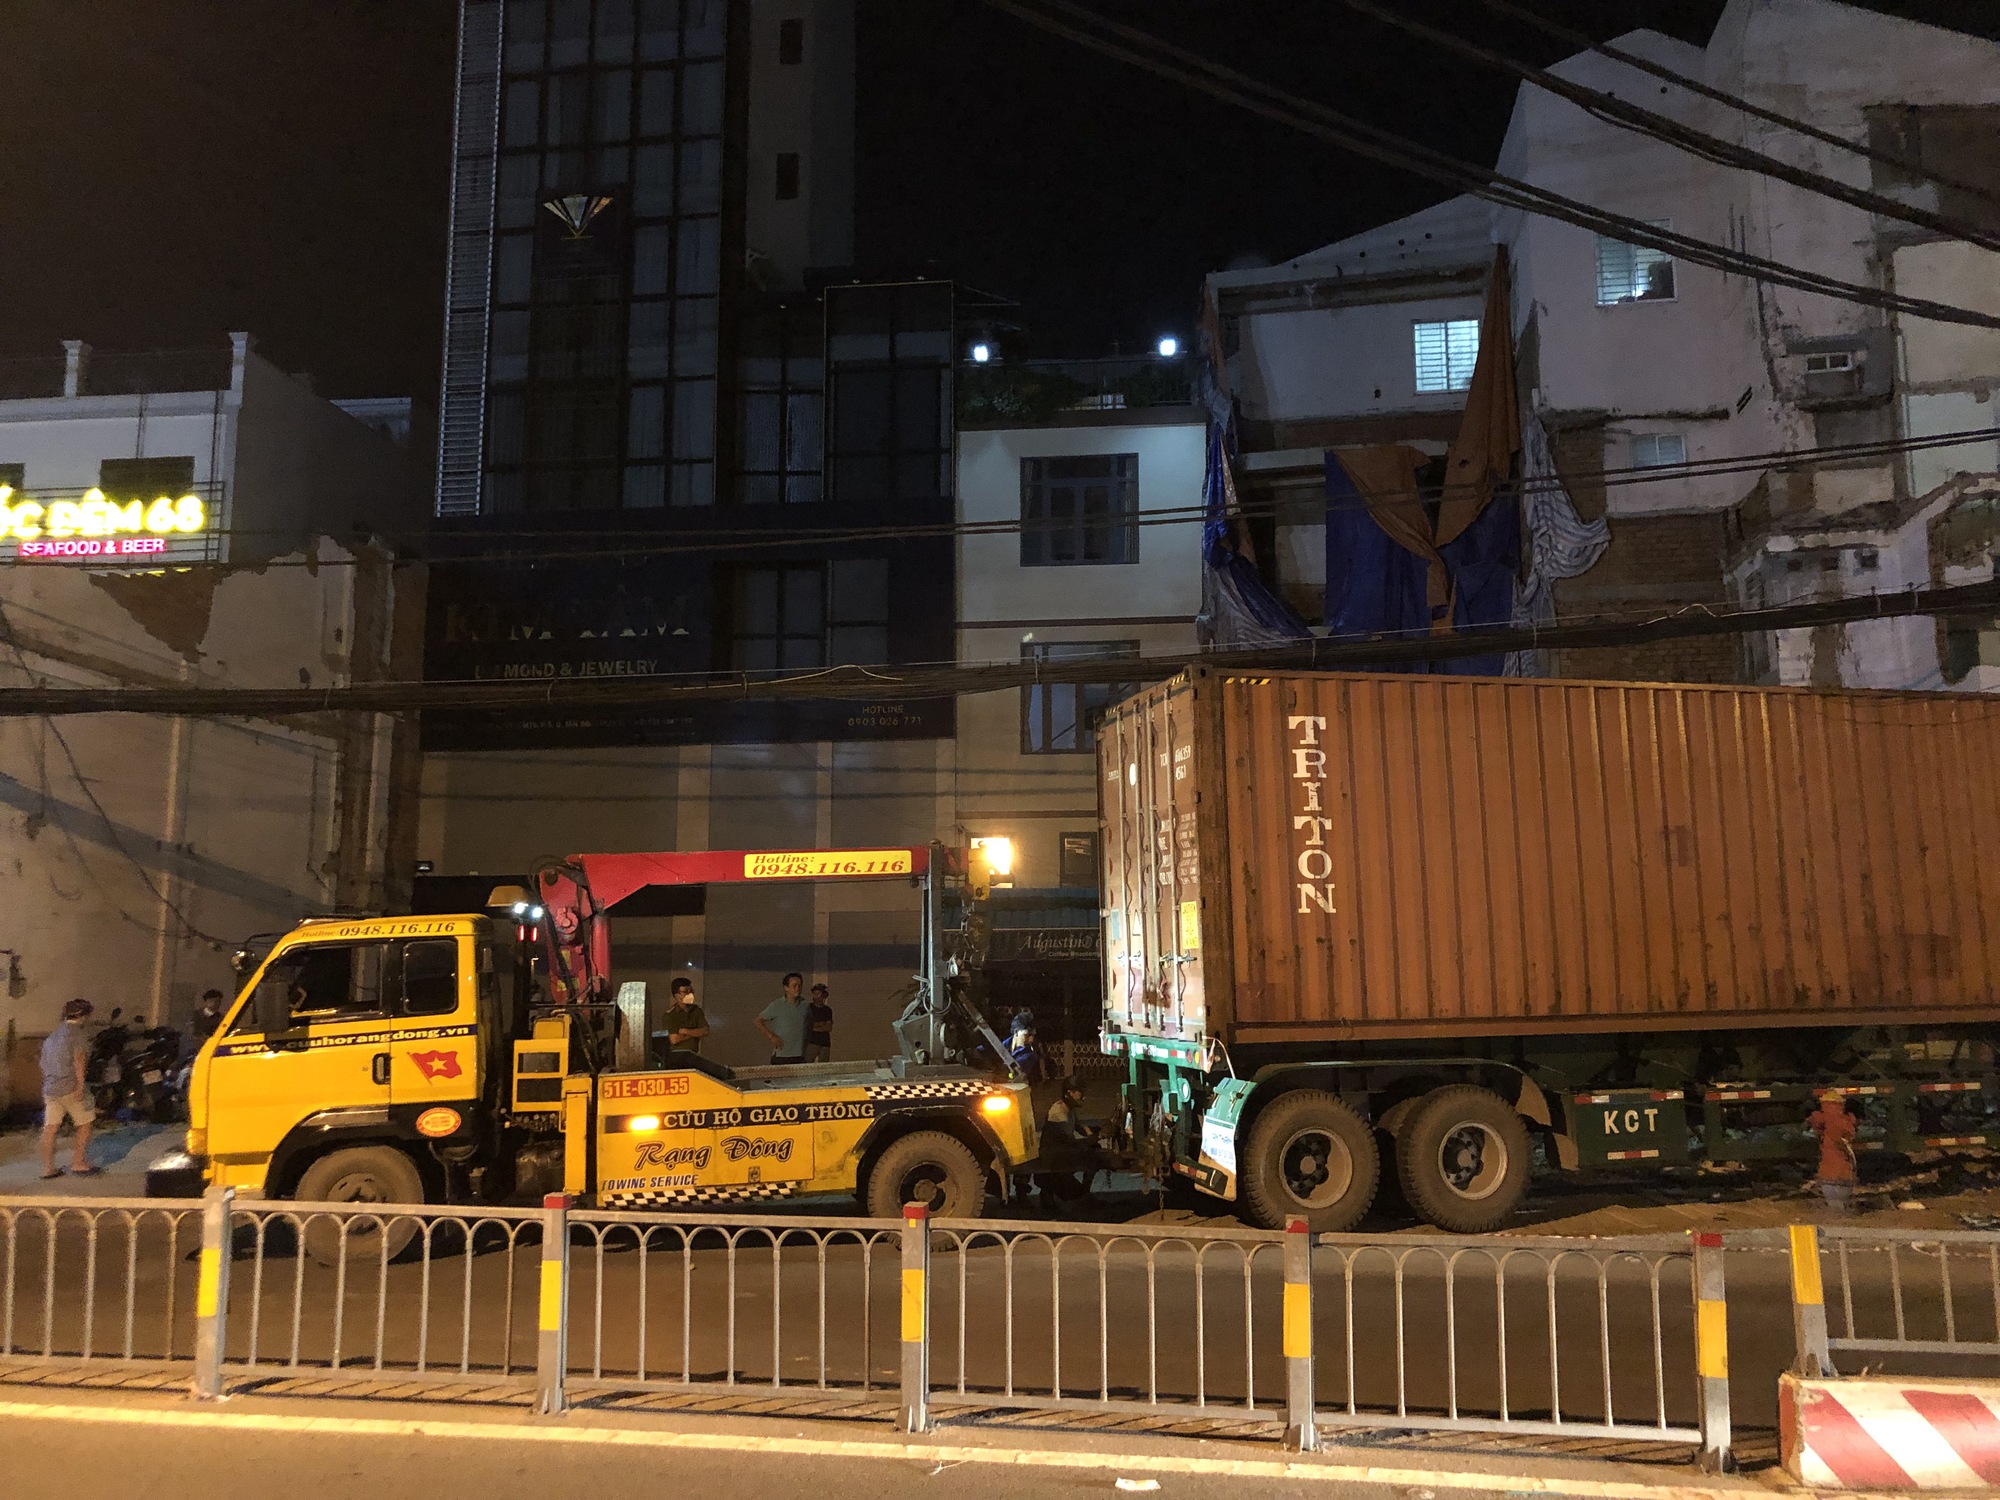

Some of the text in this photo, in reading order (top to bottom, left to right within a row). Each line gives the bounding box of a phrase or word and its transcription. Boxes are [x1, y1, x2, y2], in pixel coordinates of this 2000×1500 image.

[146, 495, 204, 532] 68
[22, 538, 165, 556] SEAFOOD & BEER
[559, 662, 572, 676] &
[578, 660, 658, 676] JEWELRY
[862, 705, 904, 714] HOTLINE
[1288, 715, 1337, 914] TRITON
[752, 861, 905, 876] 0948.116.116
[754, 856, 815, 864] Hotline:
[339, 923, 456, 937] 0948.116.116
[603, 1078, 689, 1099] 51E-030.55
[713, 1108, 742, 1126] HỘ
[750, 1107, 799, 1123] GIAO
[805, 1102, 875, 1119] THÔNG
[1604, 1108, 1658, 1134] KCT
[634, 1135, 794, 1170] Rạng Đông
[602, 1174, 699, 1191] TOWING SERVICE
